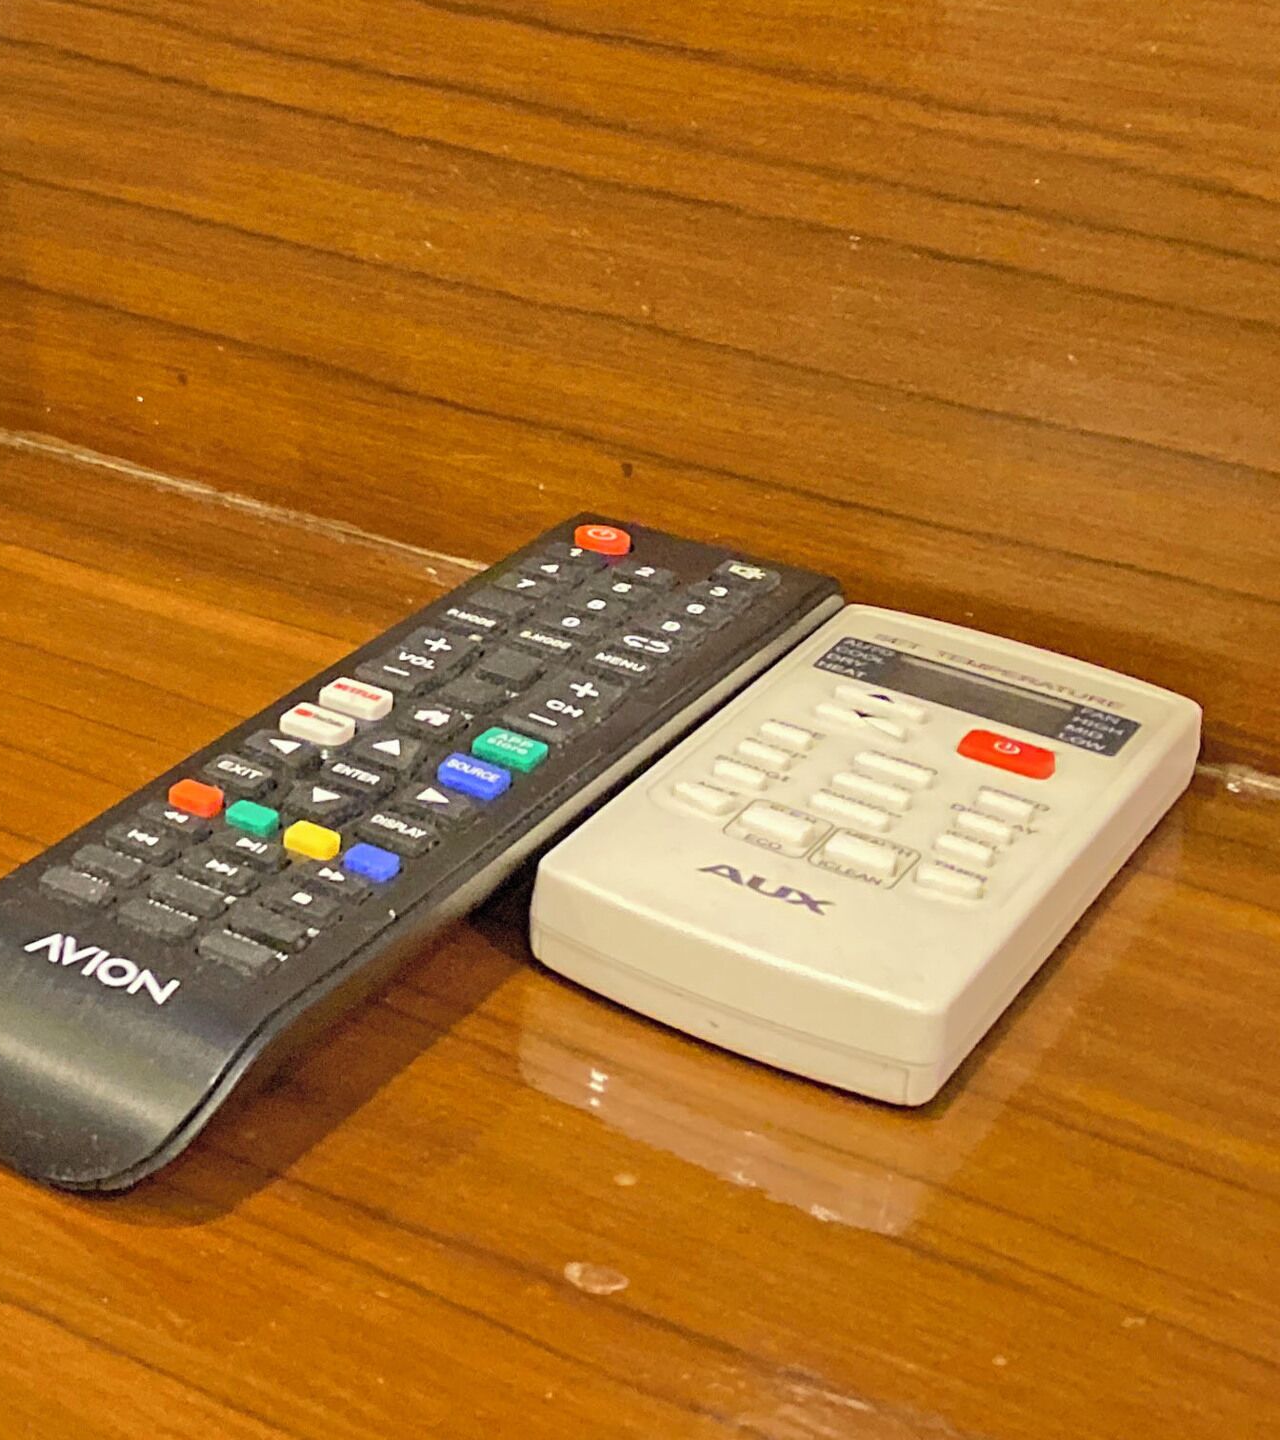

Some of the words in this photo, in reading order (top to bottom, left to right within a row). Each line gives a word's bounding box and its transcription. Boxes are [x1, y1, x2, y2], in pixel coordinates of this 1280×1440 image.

[398, 651, 436, 671] VOL
[595, 651, 647, 673] MENU
[817, 659, 868, 679] HEAT
[826, 652, 870, 668] DRY
[545, 698, 585, 719] CH
[1080, 707, 1121, 725] FAN
[1064, 724, 1104, 740] MID
[1072, 716, 1125, 737] HIGH
[1058, 732, 1107, 752] LOW
[216, 759, 264, 781] EXIT
[331, 762, 381, 786] ENTER
[445, 758, 502, 784] SOURCE
[370, 813, 427, 840] DISPLAY
[743, 833, 783, 851] ECO
[696, 864, 837, 917] AUX
[23, 931, 181, 1006] AVION
